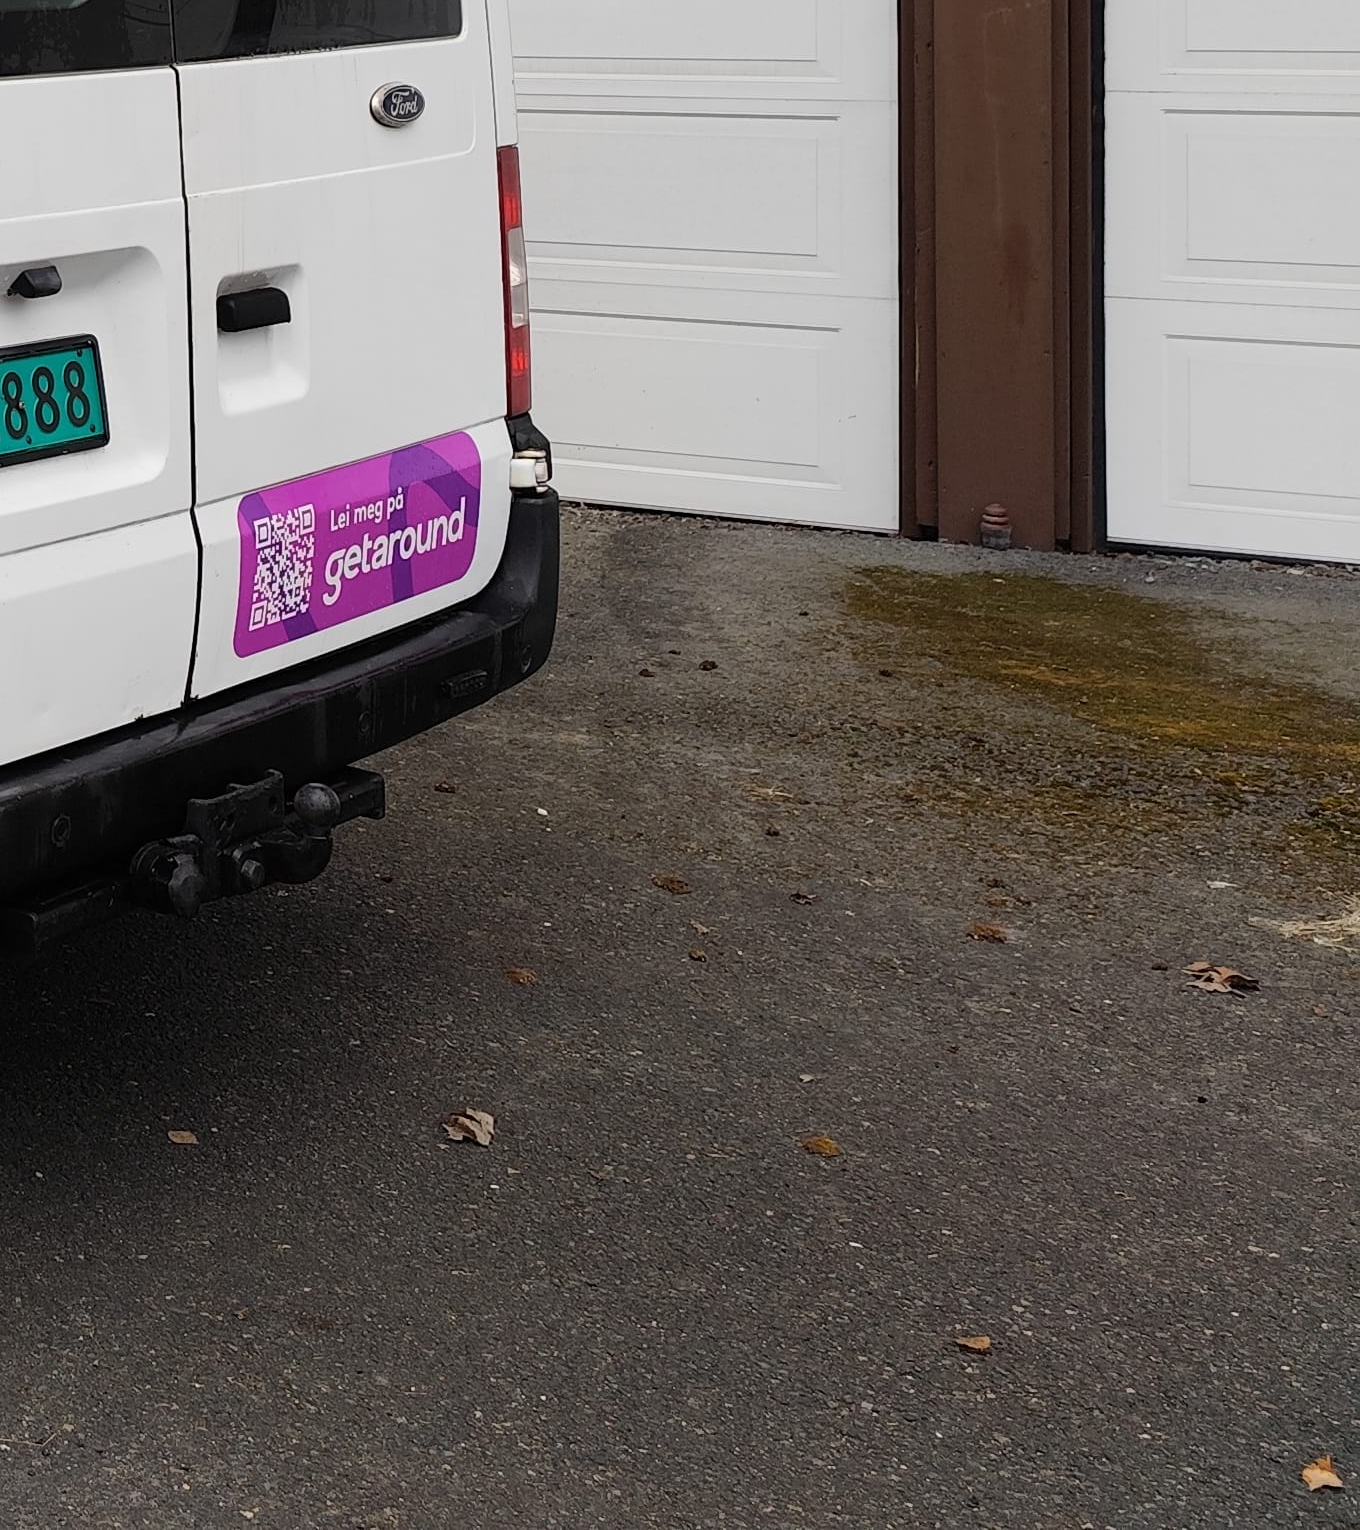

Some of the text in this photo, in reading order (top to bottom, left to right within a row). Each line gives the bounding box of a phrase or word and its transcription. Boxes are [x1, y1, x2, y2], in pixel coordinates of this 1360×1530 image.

[390, 91, 418, 116] Ford
[330, 486, 404, 532] Lei meg på
[322, 496, 466, 606] getaround
